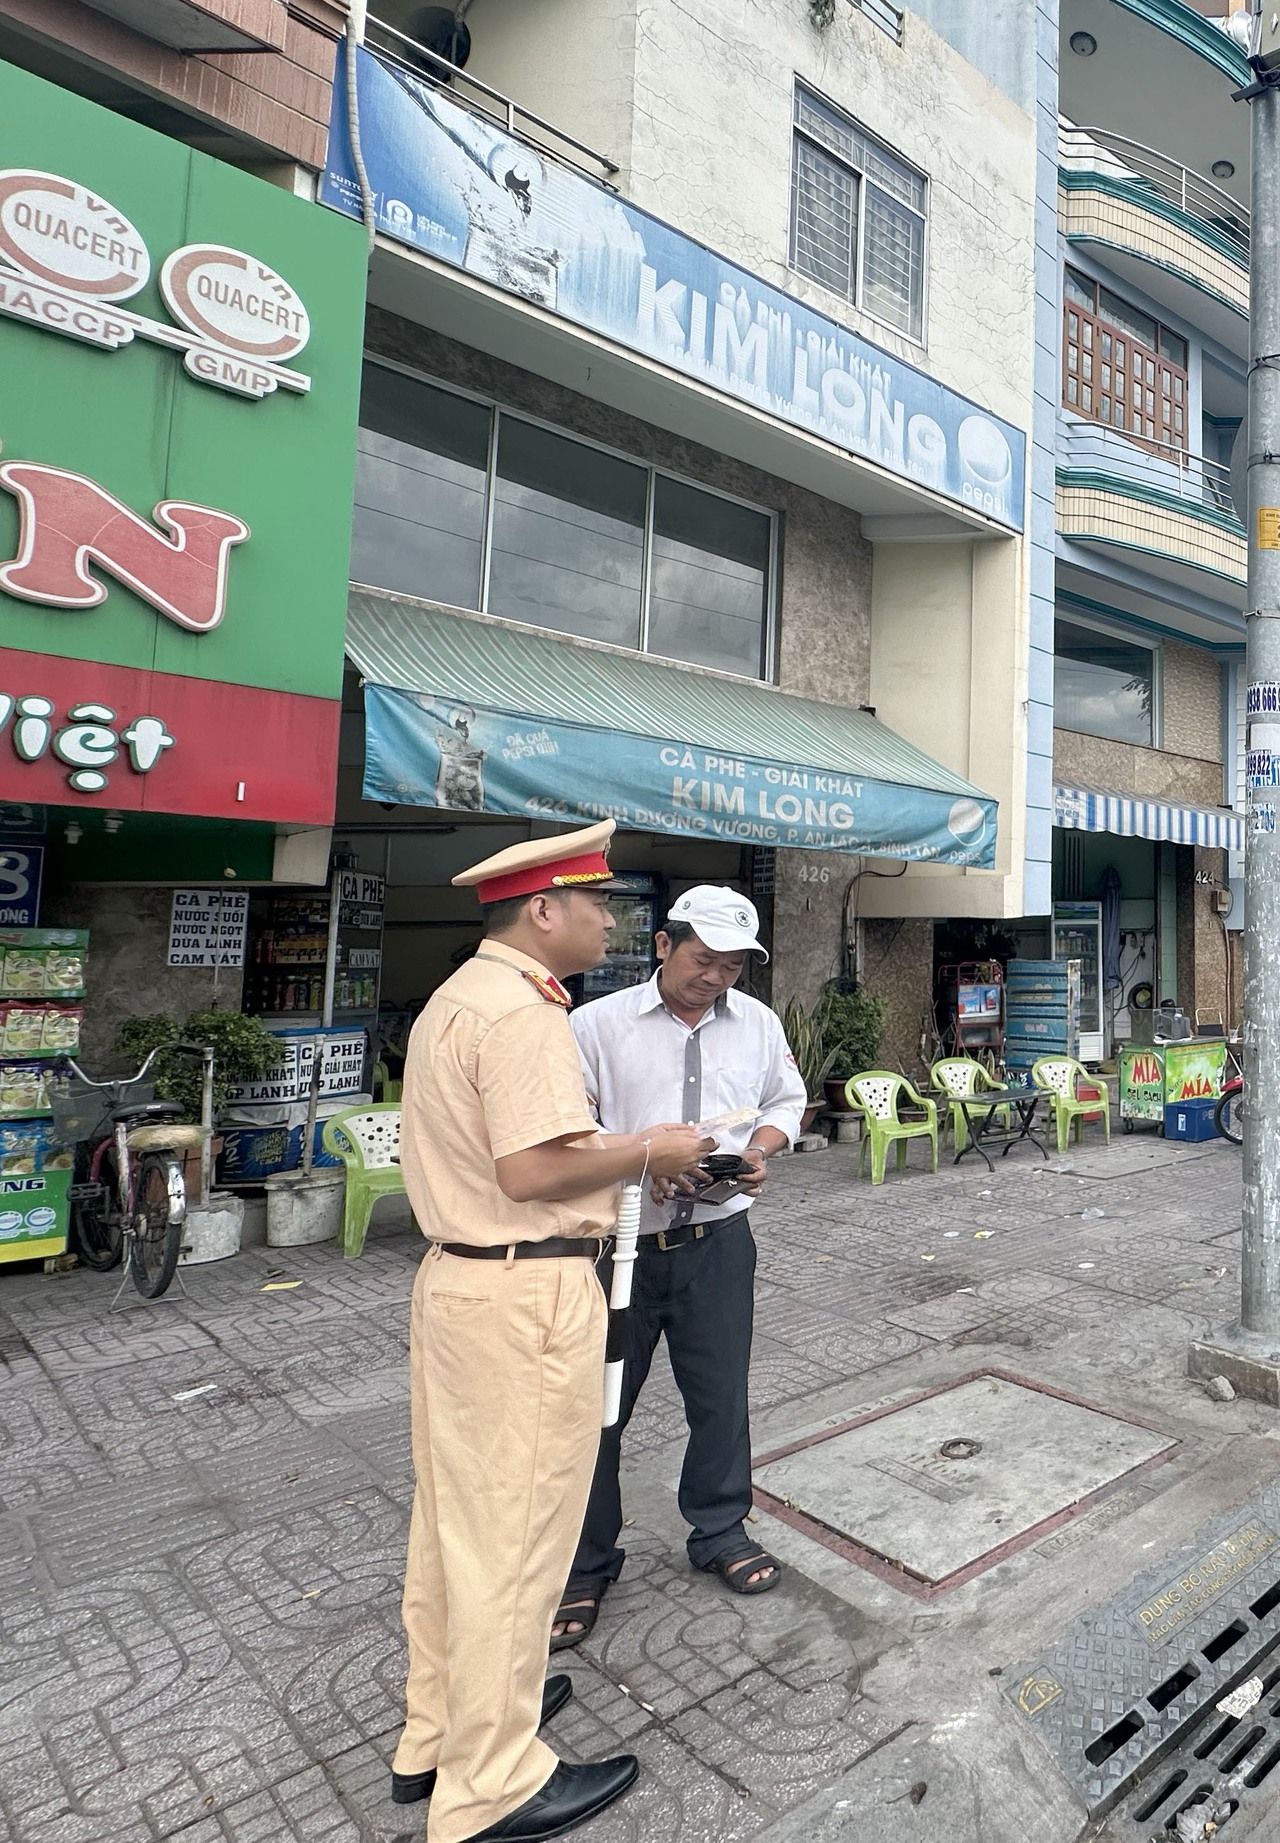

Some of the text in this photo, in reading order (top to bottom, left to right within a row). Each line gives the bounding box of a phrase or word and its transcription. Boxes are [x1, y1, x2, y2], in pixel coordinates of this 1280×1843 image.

[14, 201, 143, 272] QUACERT
[197, 273, 305, 334] QUACERT
[194, 353, 272, 392] GMP
[637, 263, 946, 462] KIM LONG
[660, 744, 697, 770] CÀ
[764, 765, 808, 790] GIẢI
[815, 775, 864, 798] KHÁT
[672, 776, 855, 830] KIM LONG
[525, 797, 568, 815] 426
[576, 801, 628, 822] KINH
[712, 817, 781, 843] VƯƠNG,
[805, 830, 826, 846] AN
[798, 864, 830, 883] 426
[1196, 870, 1215, 885] 424
[343, 872, 358, 900] CÀ
[176, 892, 246, 908] CÀ PHÊ
[171, 936, 200, 948] DỪA
[210, 925, 243, 937] NGỌT
[170, 953, 204, 965] CAM
[330, 1041, 363, 1057] PHÊ
[325, 1059, 341, 1074] GIẢI
[342, 1058, 362, 1073] KHÁT
[1132, 1049, 1162, 1085] MÍA
[250, 1084, 295, 1101] LẠNH
[329, 1076, 360, 1092] LẠNH
[1181, 1073, 1213, 1099] MÍA
